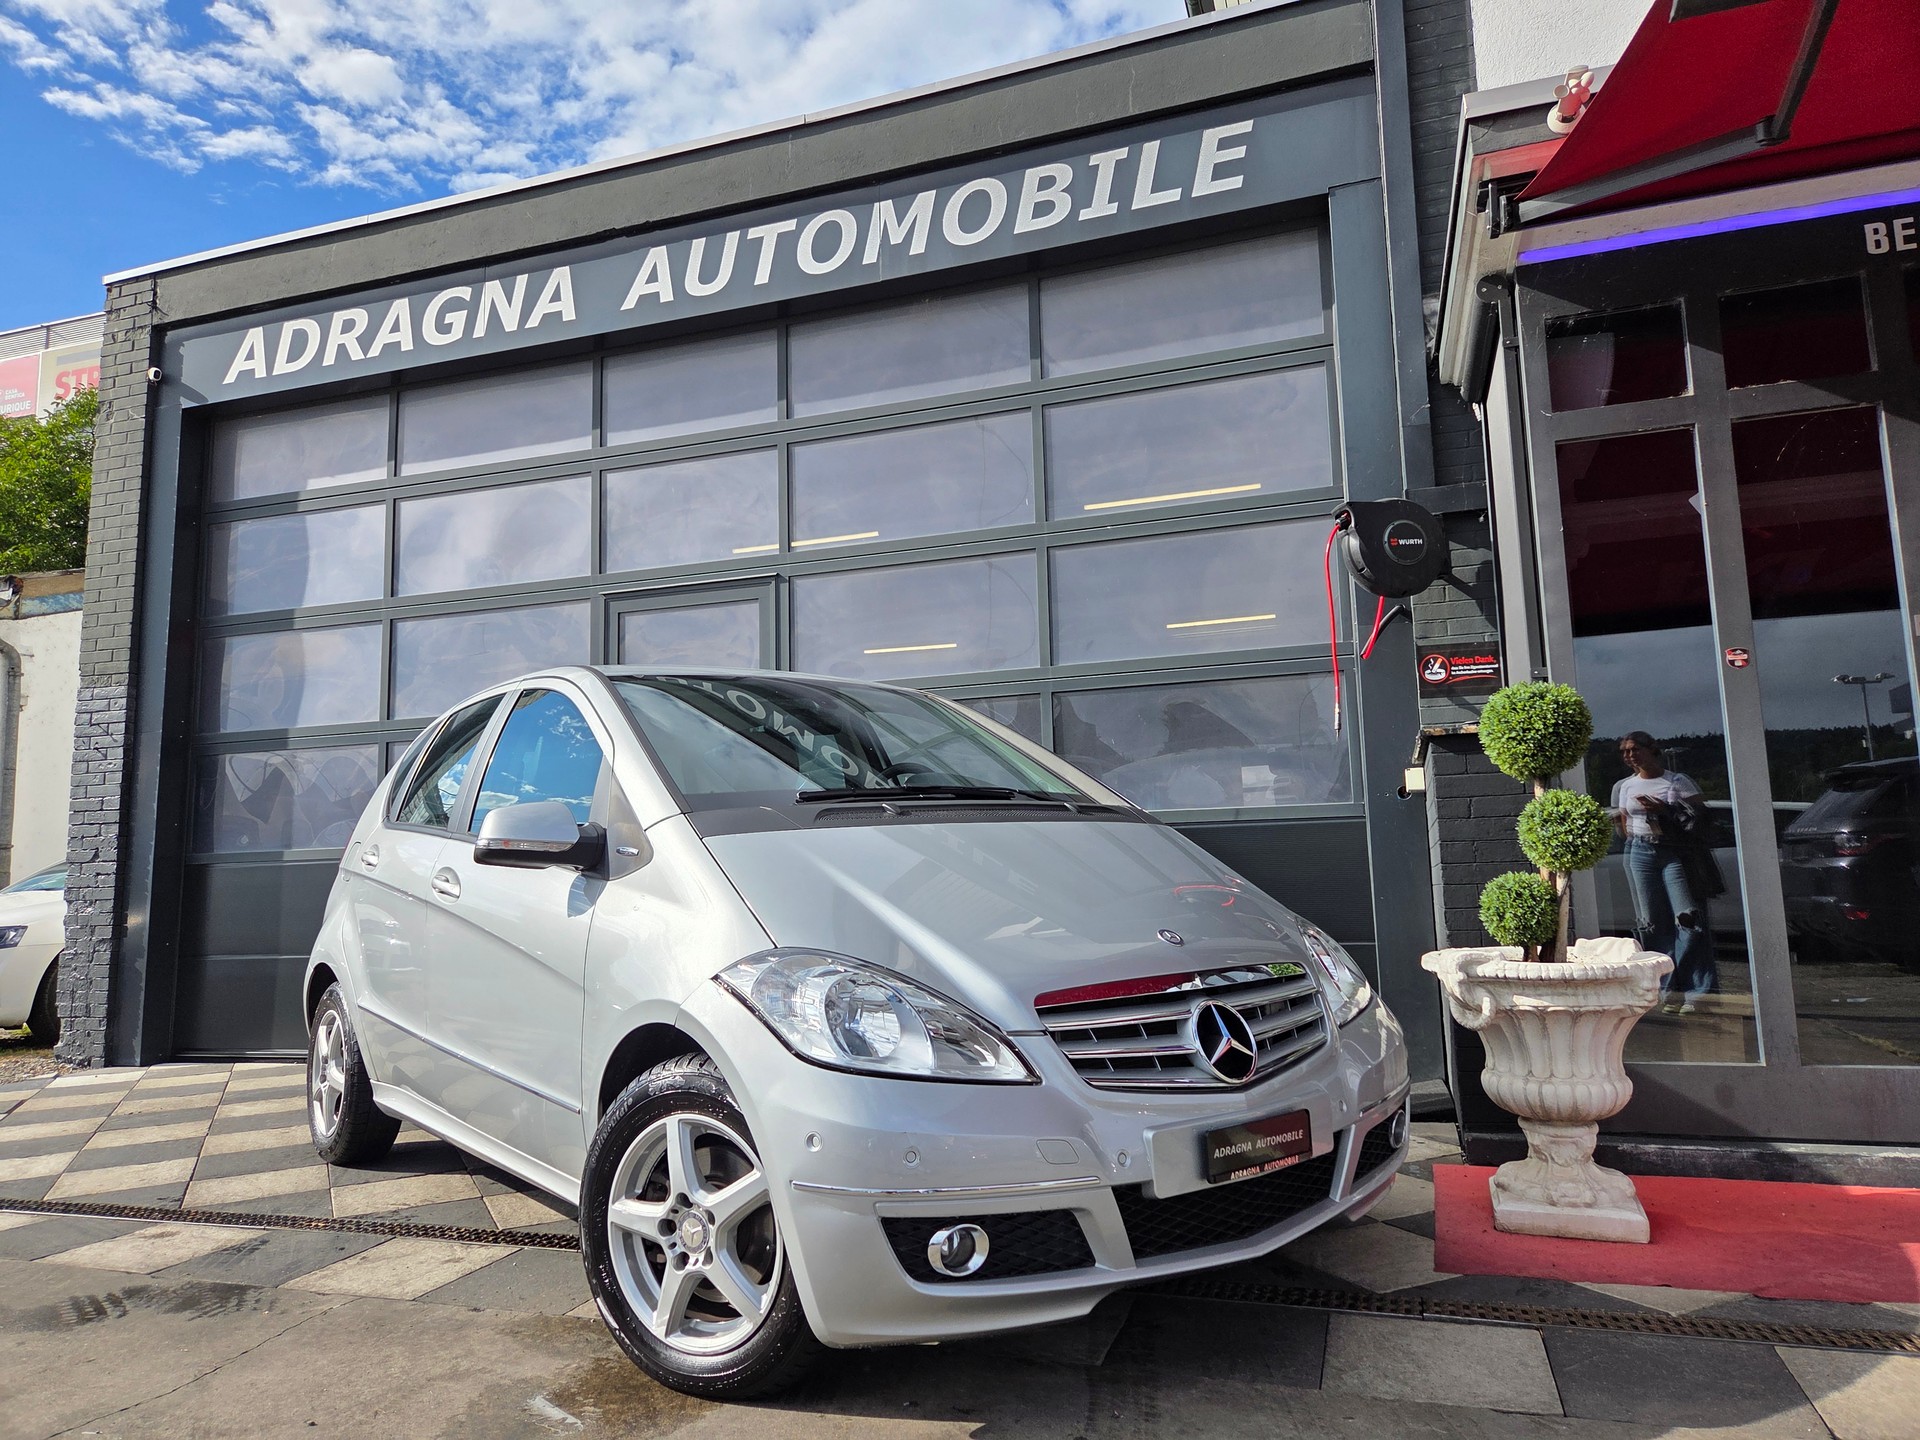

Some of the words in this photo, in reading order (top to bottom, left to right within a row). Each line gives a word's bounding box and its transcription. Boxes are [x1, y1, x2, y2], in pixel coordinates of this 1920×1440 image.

[223, 265, 577, 384] ADRAGNA
[620, 119, 1254, 311] AUTOMOBILE
[1450, 656, 1474, 665] Vielen
[1214, 1141, 1252, 1159] ADRAGNA
[1256, 1129, 1303, 1149] AUTOMOBILE
[1230, 1165, 1260, 1180] ADRAGNA
[1264, 1155, 1299, 1171] AUTOMOBILE
